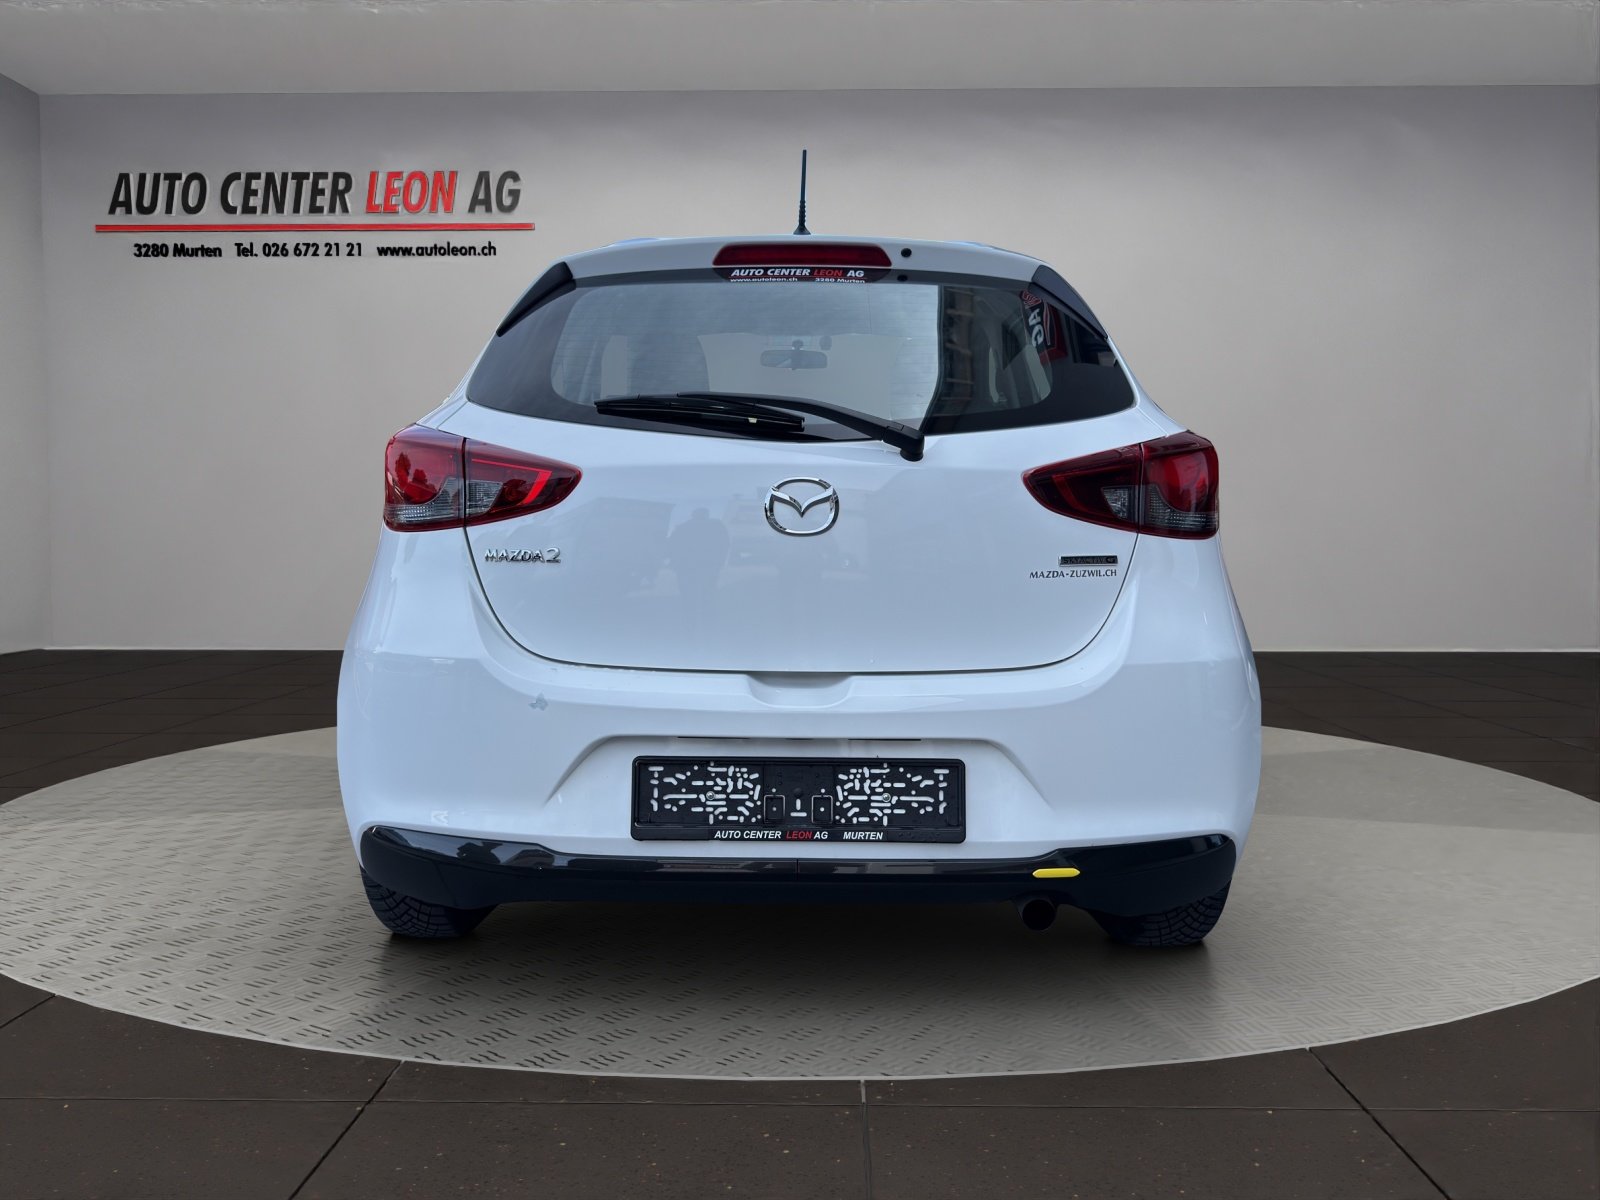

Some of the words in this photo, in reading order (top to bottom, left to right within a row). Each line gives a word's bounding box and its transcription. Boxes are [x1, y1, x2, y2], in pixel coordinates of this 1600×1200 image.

[108, 171, 208, 215] AUTO
[220, 171, 353, 214] CENTER
[365, 170, 459, 214] LEON
[467, 170, 522, 214] AG
[133, 243, 170, 258] 3280
[172, 243, 222, 258] Murten
[235, 242, 258, 258] Tel.
[262, 242, 290, 258] 026
[293, 242, 321, 258] 672
[324, 242, 340, 257] 21
[347, 242, 363, 257] 21
[376, 241, 497, 258] www.autoleon.ch
[731, 268, 764, 276] AUTO
[767, 268, 811, 276] CENTER
[814, 269, 843, 277] LEON
[1029, 569, 1117, 579] MAZDA-ZUZWIL.CH
[714, 830, 742, 839] AUTO
[743, 830, 781, 839] CENTER
[786, 831, 812, 840] LEON
[814, 832, 828, 840] AG
[843, 832, 883, 840] MURTEN
